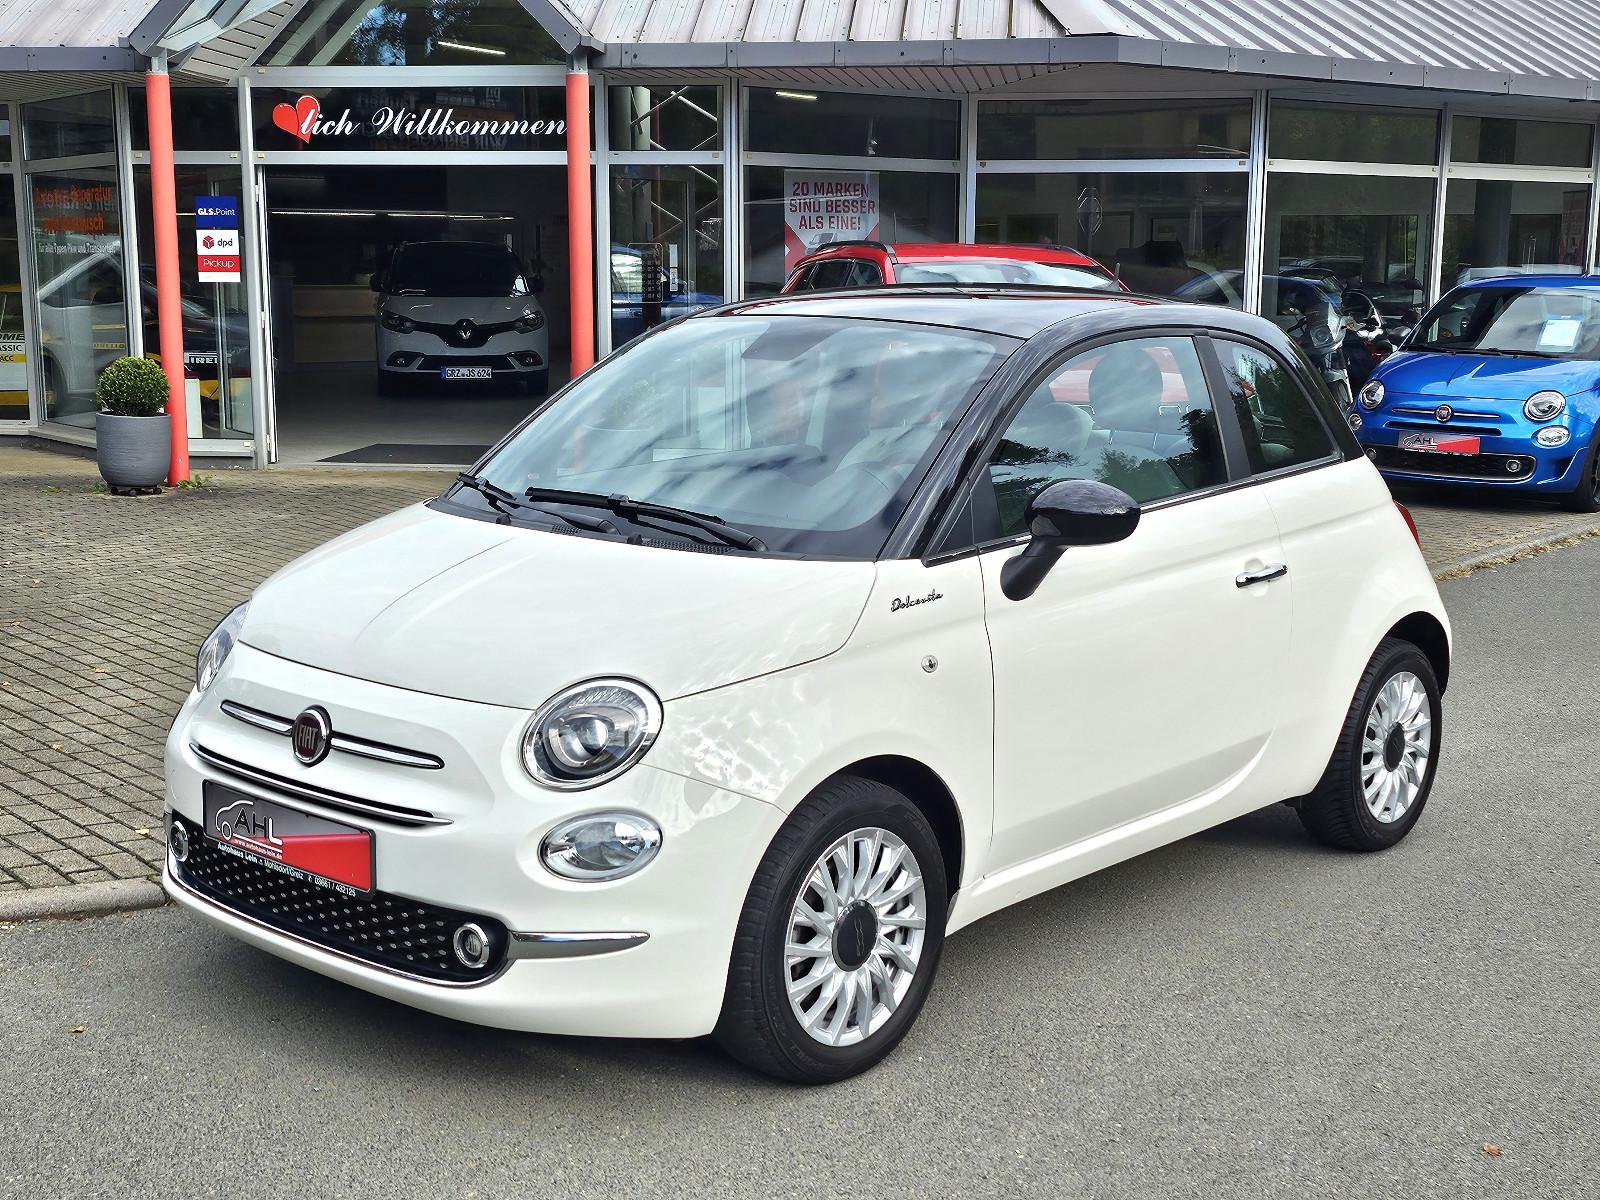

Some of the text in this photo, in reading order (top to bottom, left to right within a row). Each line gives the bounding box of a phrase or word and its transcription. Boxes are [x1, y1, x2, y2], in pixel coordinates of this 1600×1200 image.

[371, 106, 567, 137] Willkommen
[792, 181, 870, 198] 20 MARKEN
[789, 197, 877, 214] SIND BESSER
[798, 215, 861, 231] ALS EINE!
[217, 238, 233, 248] dpd
[203, 258, 235, 269] Pickup
[298, 724, 319, 750] FIAT
[233, 807, 284, 846] AHL
[217, 841, 244, 859] Autohaus
